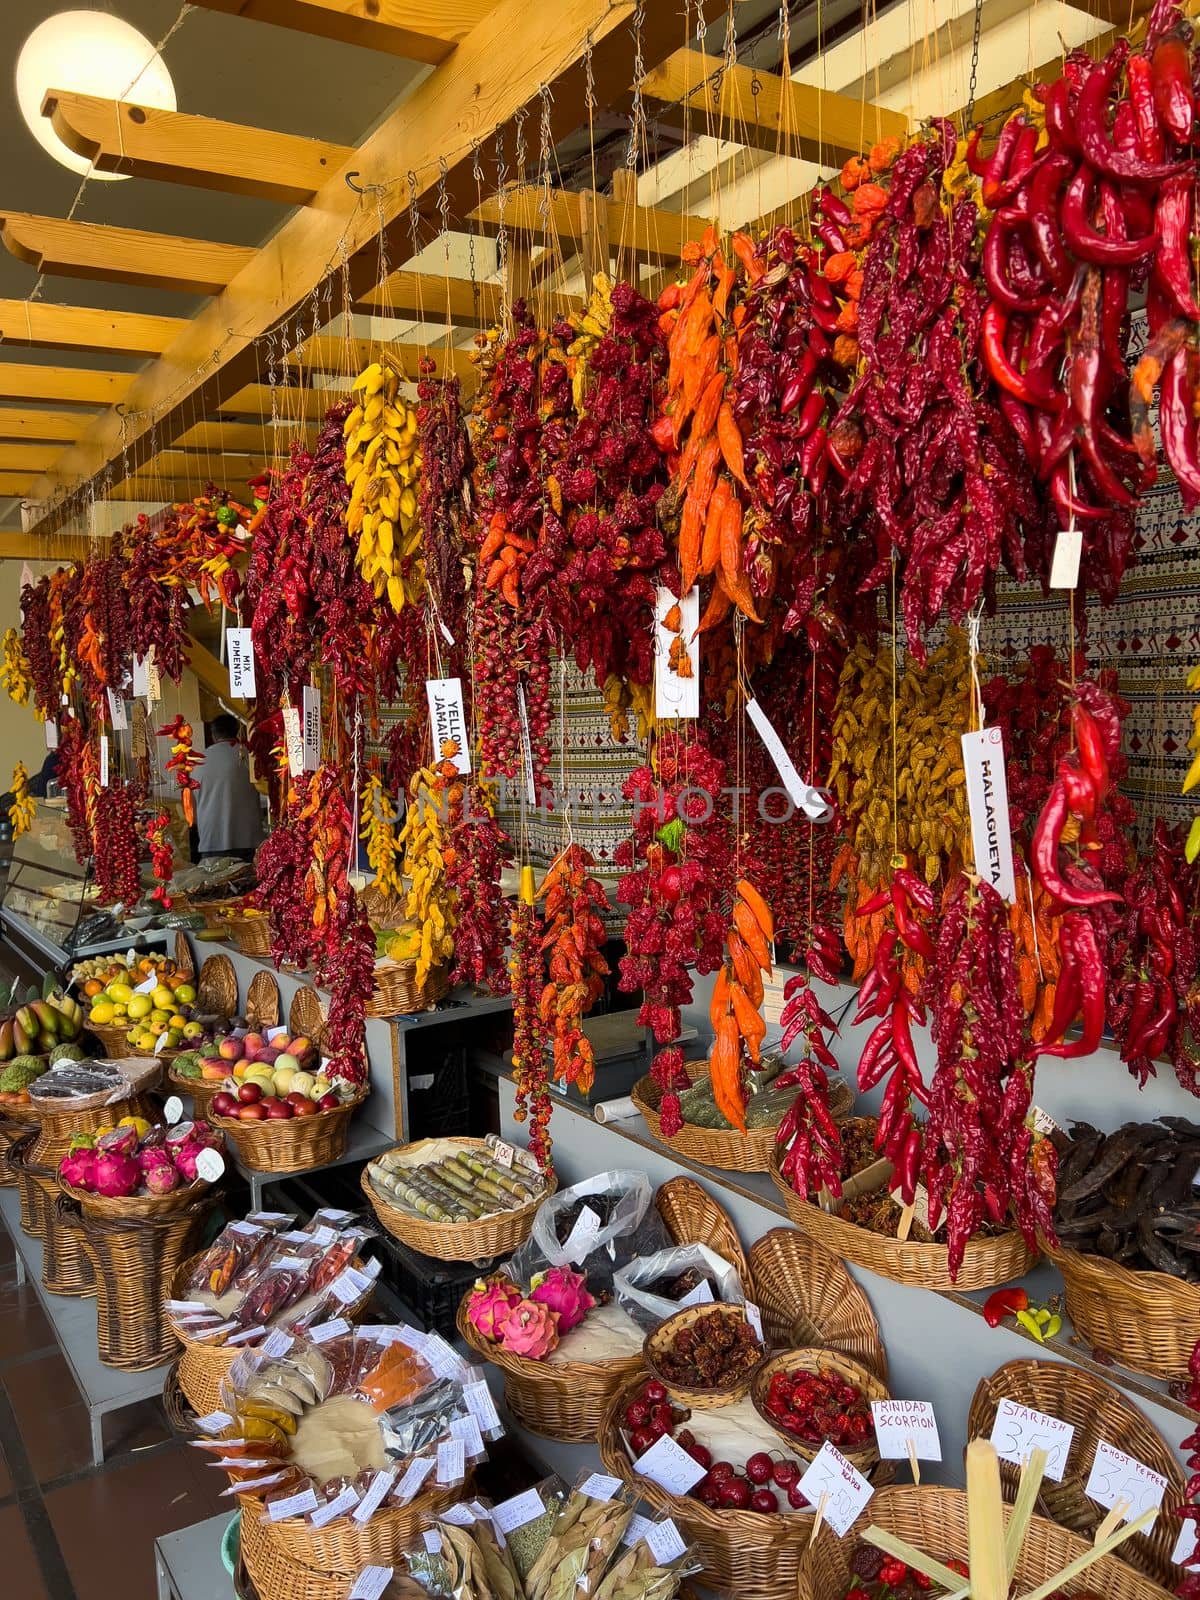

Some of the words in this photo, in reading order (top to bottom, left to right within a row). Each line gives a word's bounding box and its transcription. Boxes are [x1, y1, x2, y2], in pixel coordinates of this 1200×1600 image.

[232, 640, 242, 687] PIMENTAS
[242, 655, 251, 673] MIX
[981, 759, 1001, 885] MALAGUETA
[872, 1401, 926, 1413] TRINIDAD
[824, 1443, 855, 1474] CAROLINA
[1100, 1443, 1131, 1466] GHOST
[1135, 1463, 1166, 1489] PEPPER
[841, 1469, 862, 1493] REAPER
